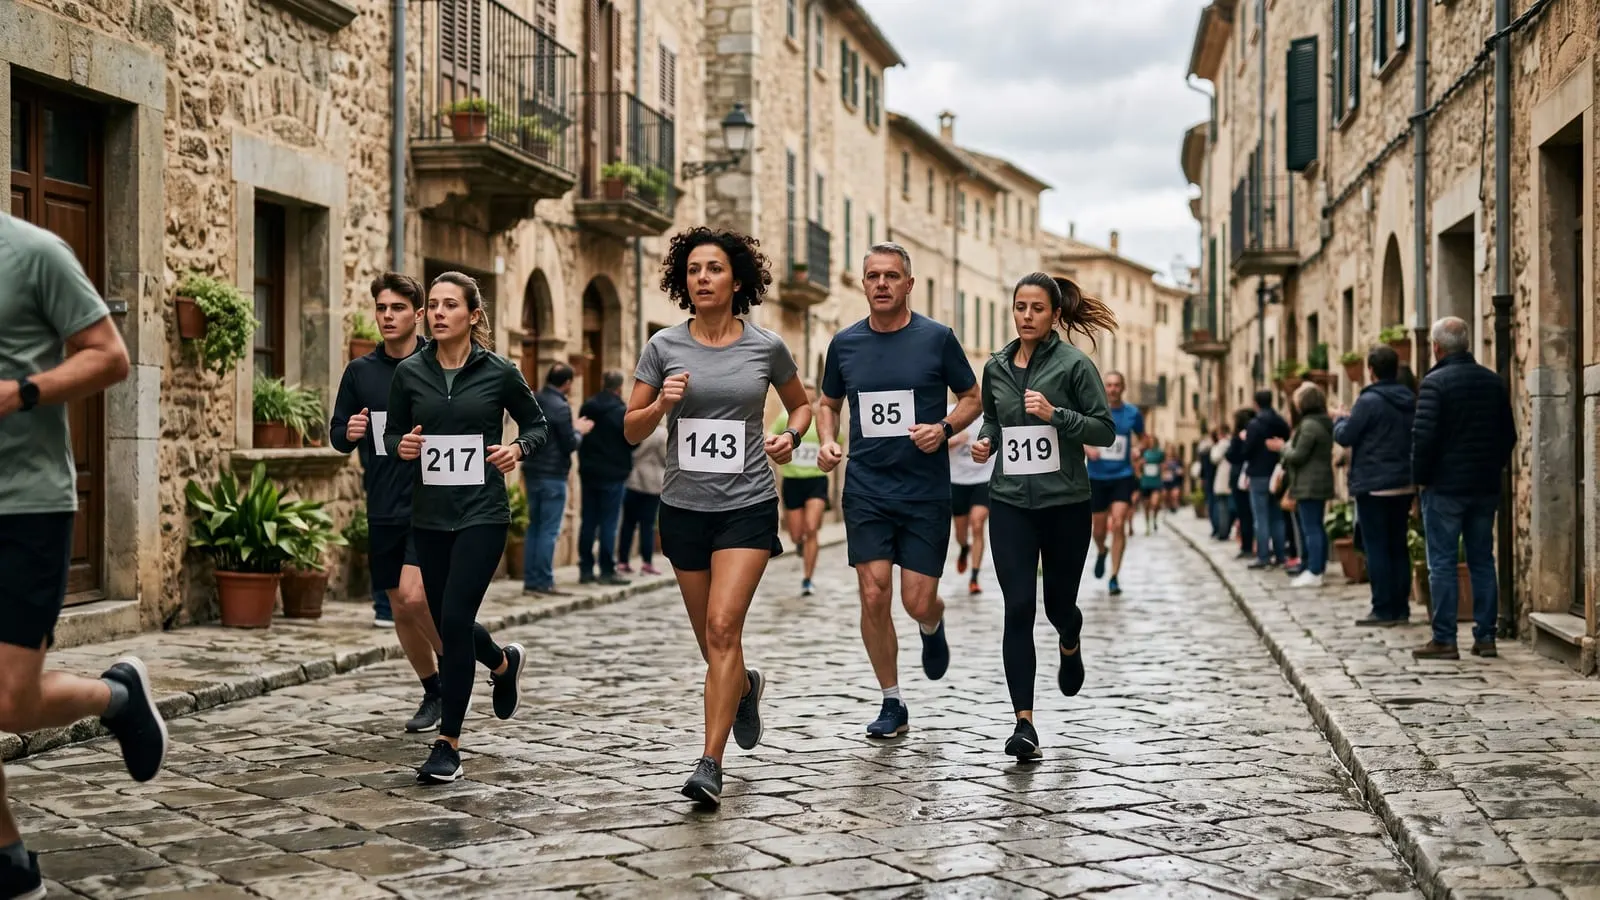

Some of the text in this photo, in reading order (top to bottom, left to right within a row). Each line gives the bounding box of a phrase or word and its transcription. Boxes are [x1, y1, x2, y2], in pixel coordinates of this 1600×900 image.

[871, 403, 902, 425] 85
[685, 432, 737, 459] 143
[1007, 438, 1052, 462] 319
[426, 448, 476, 472] 217
